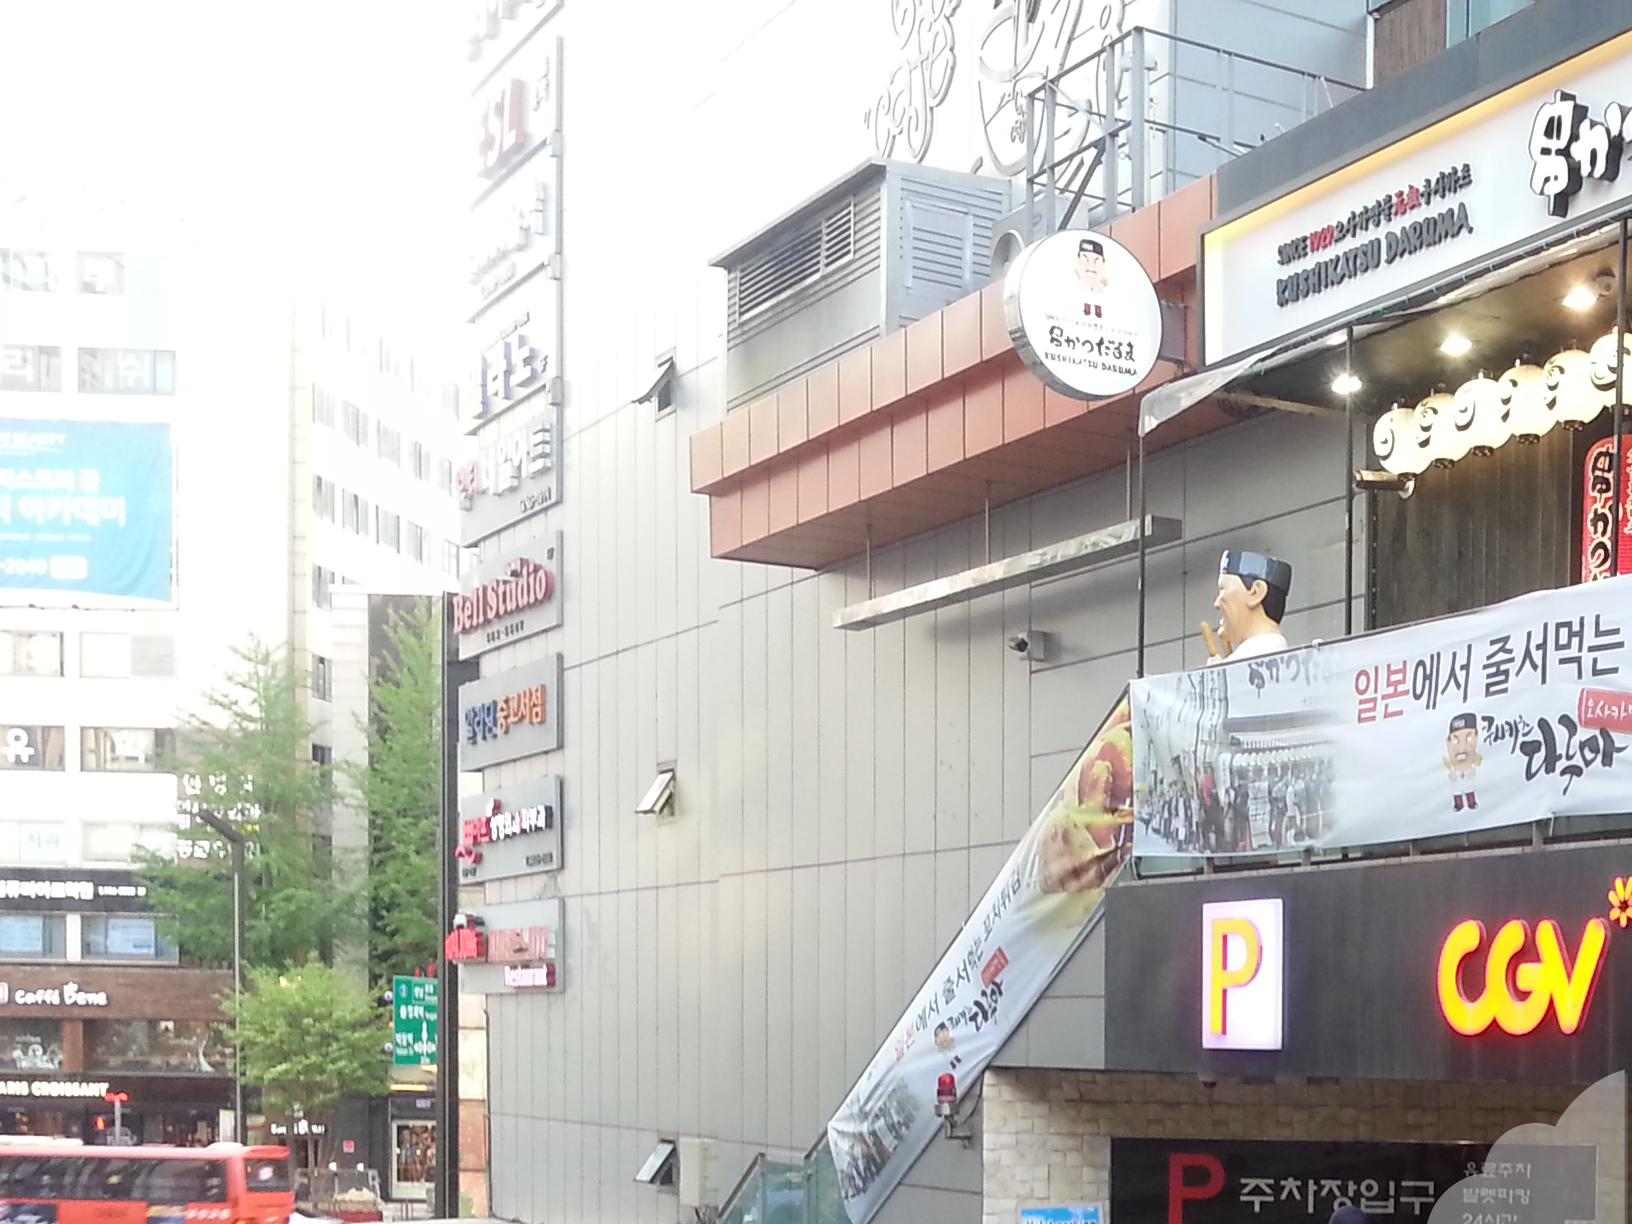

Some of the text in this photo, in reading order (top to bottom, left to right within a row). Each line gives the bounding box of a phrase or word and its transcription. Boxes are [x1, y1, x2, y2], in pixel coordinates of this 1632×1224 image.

[1276, 202, 1474, 307] KUSHIKATSU DARUMA
[1277, 235, 1309, 265] SINCE
[453, 585, 486, 634] Bell
[485, 562, 549, 621] Studio
[1353, 647, 1473, 724] 일본에서
[1481, 616, 1626, 698] 줄서먹는
[1210, 916, 1263, 1037] P
[1436, 916, 1612, 1037] CGV
[1238, 1175, 1436, 1216] 주차장입구
